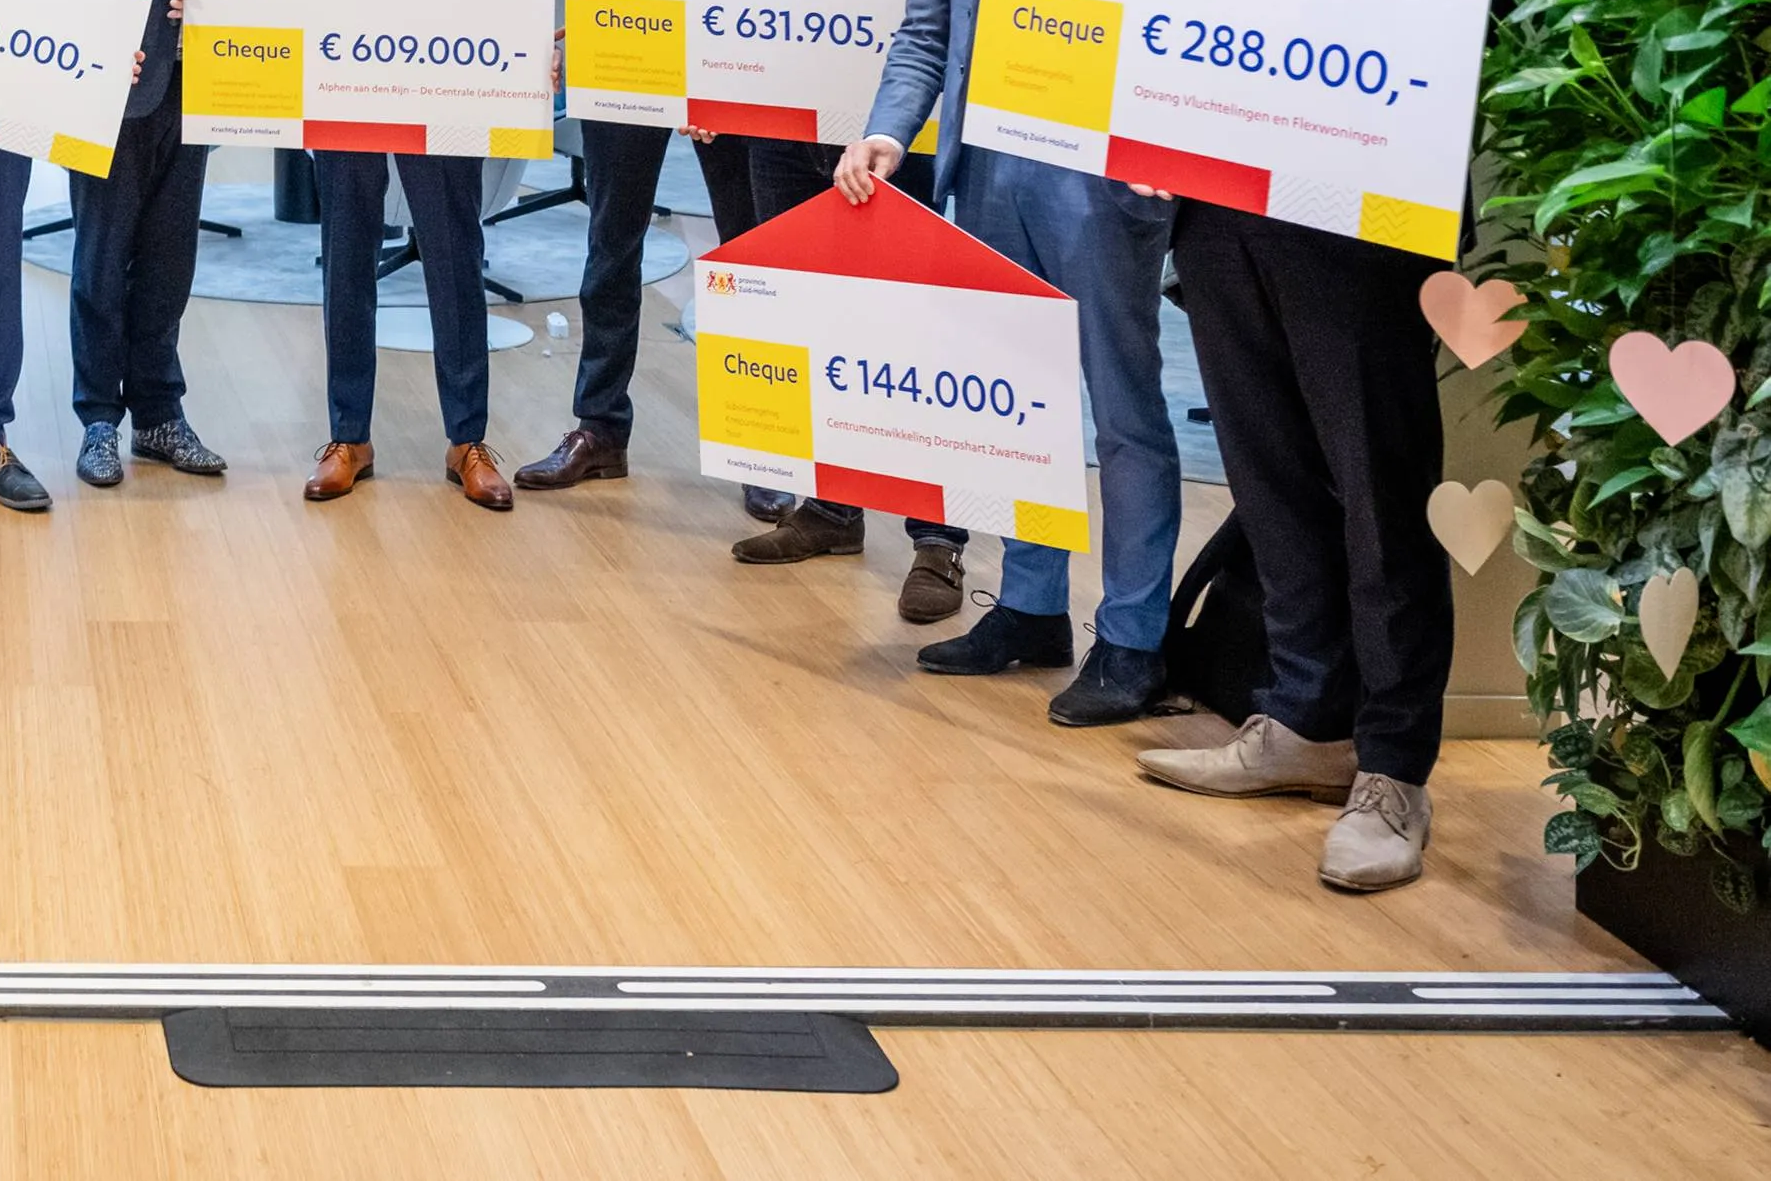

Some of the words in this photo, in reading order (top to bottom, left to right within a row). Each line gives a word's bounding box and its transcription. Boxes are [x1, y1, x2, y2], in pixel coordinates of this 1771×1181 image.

[594, 7, 673, 35] Cheque
[701, 4, 725, 36] €
[1012, 5, 1105, 45] Cheque
[211, 37, 291, 63] Cheque
[318, 31, 341, 61] €
[351, 33, 527, 72] 609.000,-
[701, 57, 734, 71] Puerto
[735, 61, 765, 73] Verde
[1140, 13, 1171, 56] €
[1179, 19, 1429, 106] 288.000,-
[317, 81, 352, 93] Alphen
[352, 84, 370, 93] aan
[370, 83, 390, 94] den
[390, 84, 410, 96] Rijn
[419, 85, 434, 96] De
[433, 86, 475, 97] Centrale
[476, 87, 551, 101] (asfaltcentrale)
[1132, 84, 1180, 107] Opvang
[1182, 94, 1270, 123] Vluchtelingen
[1271, 114, 1290, 126] en
[1291, 115, 1388, 147] Flexwoningen
[723, 352, 798, 386] Cheque
[824, 354, 848, 392] €
[856, 358, 1046, 426] 144.000,-
[825, 416, 932, 448] Centrumontwikkeling
[932, 434, 987, 455] Dorpshart
[987, 443, 1052, 465] Zwartewaal
